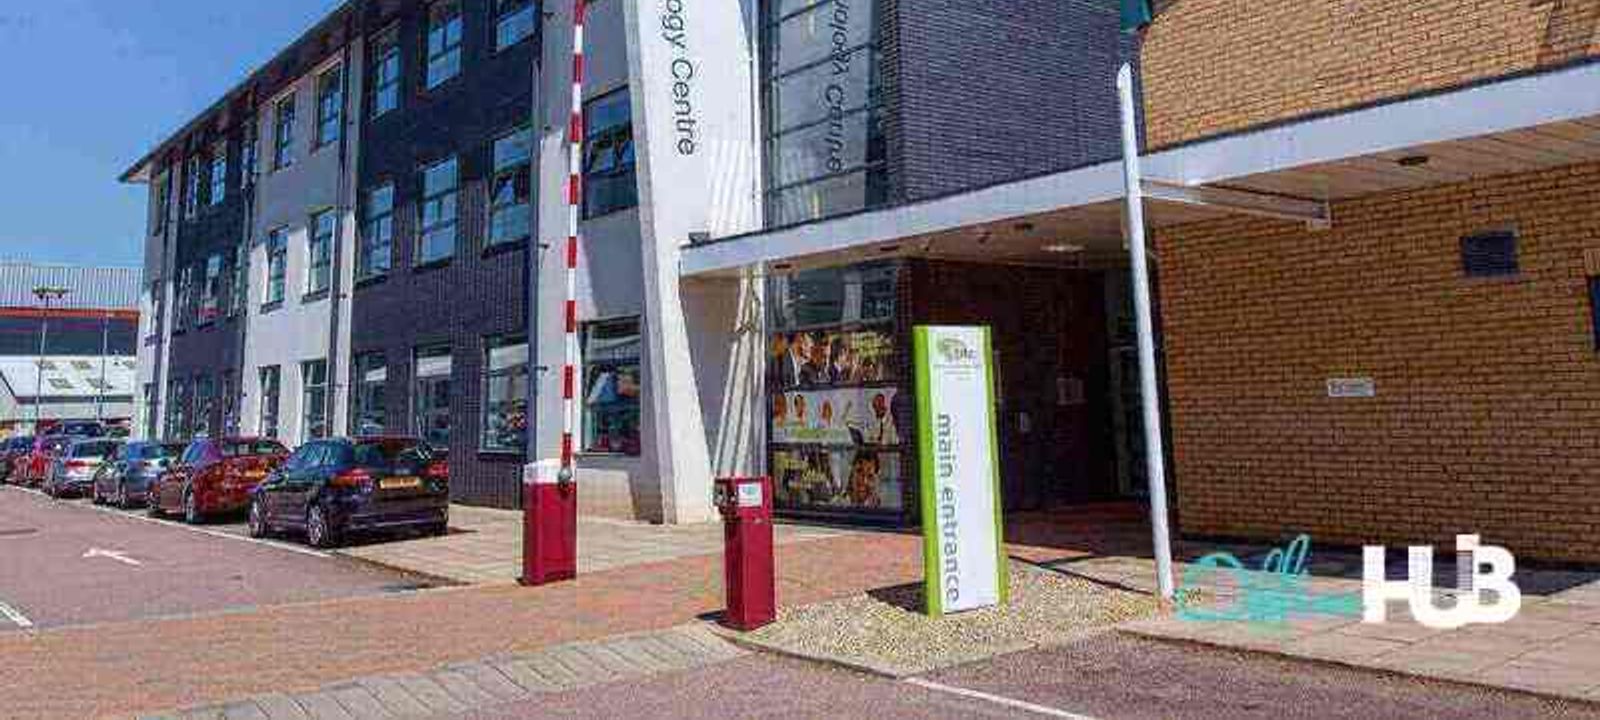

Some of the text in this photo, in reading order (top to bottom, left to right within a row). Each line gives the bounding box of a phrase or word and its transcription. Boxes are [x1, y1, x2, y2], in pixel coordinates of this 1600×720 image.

[671, 59, 697, 156] Centre
[937, 413, 960, 602] main entrance
